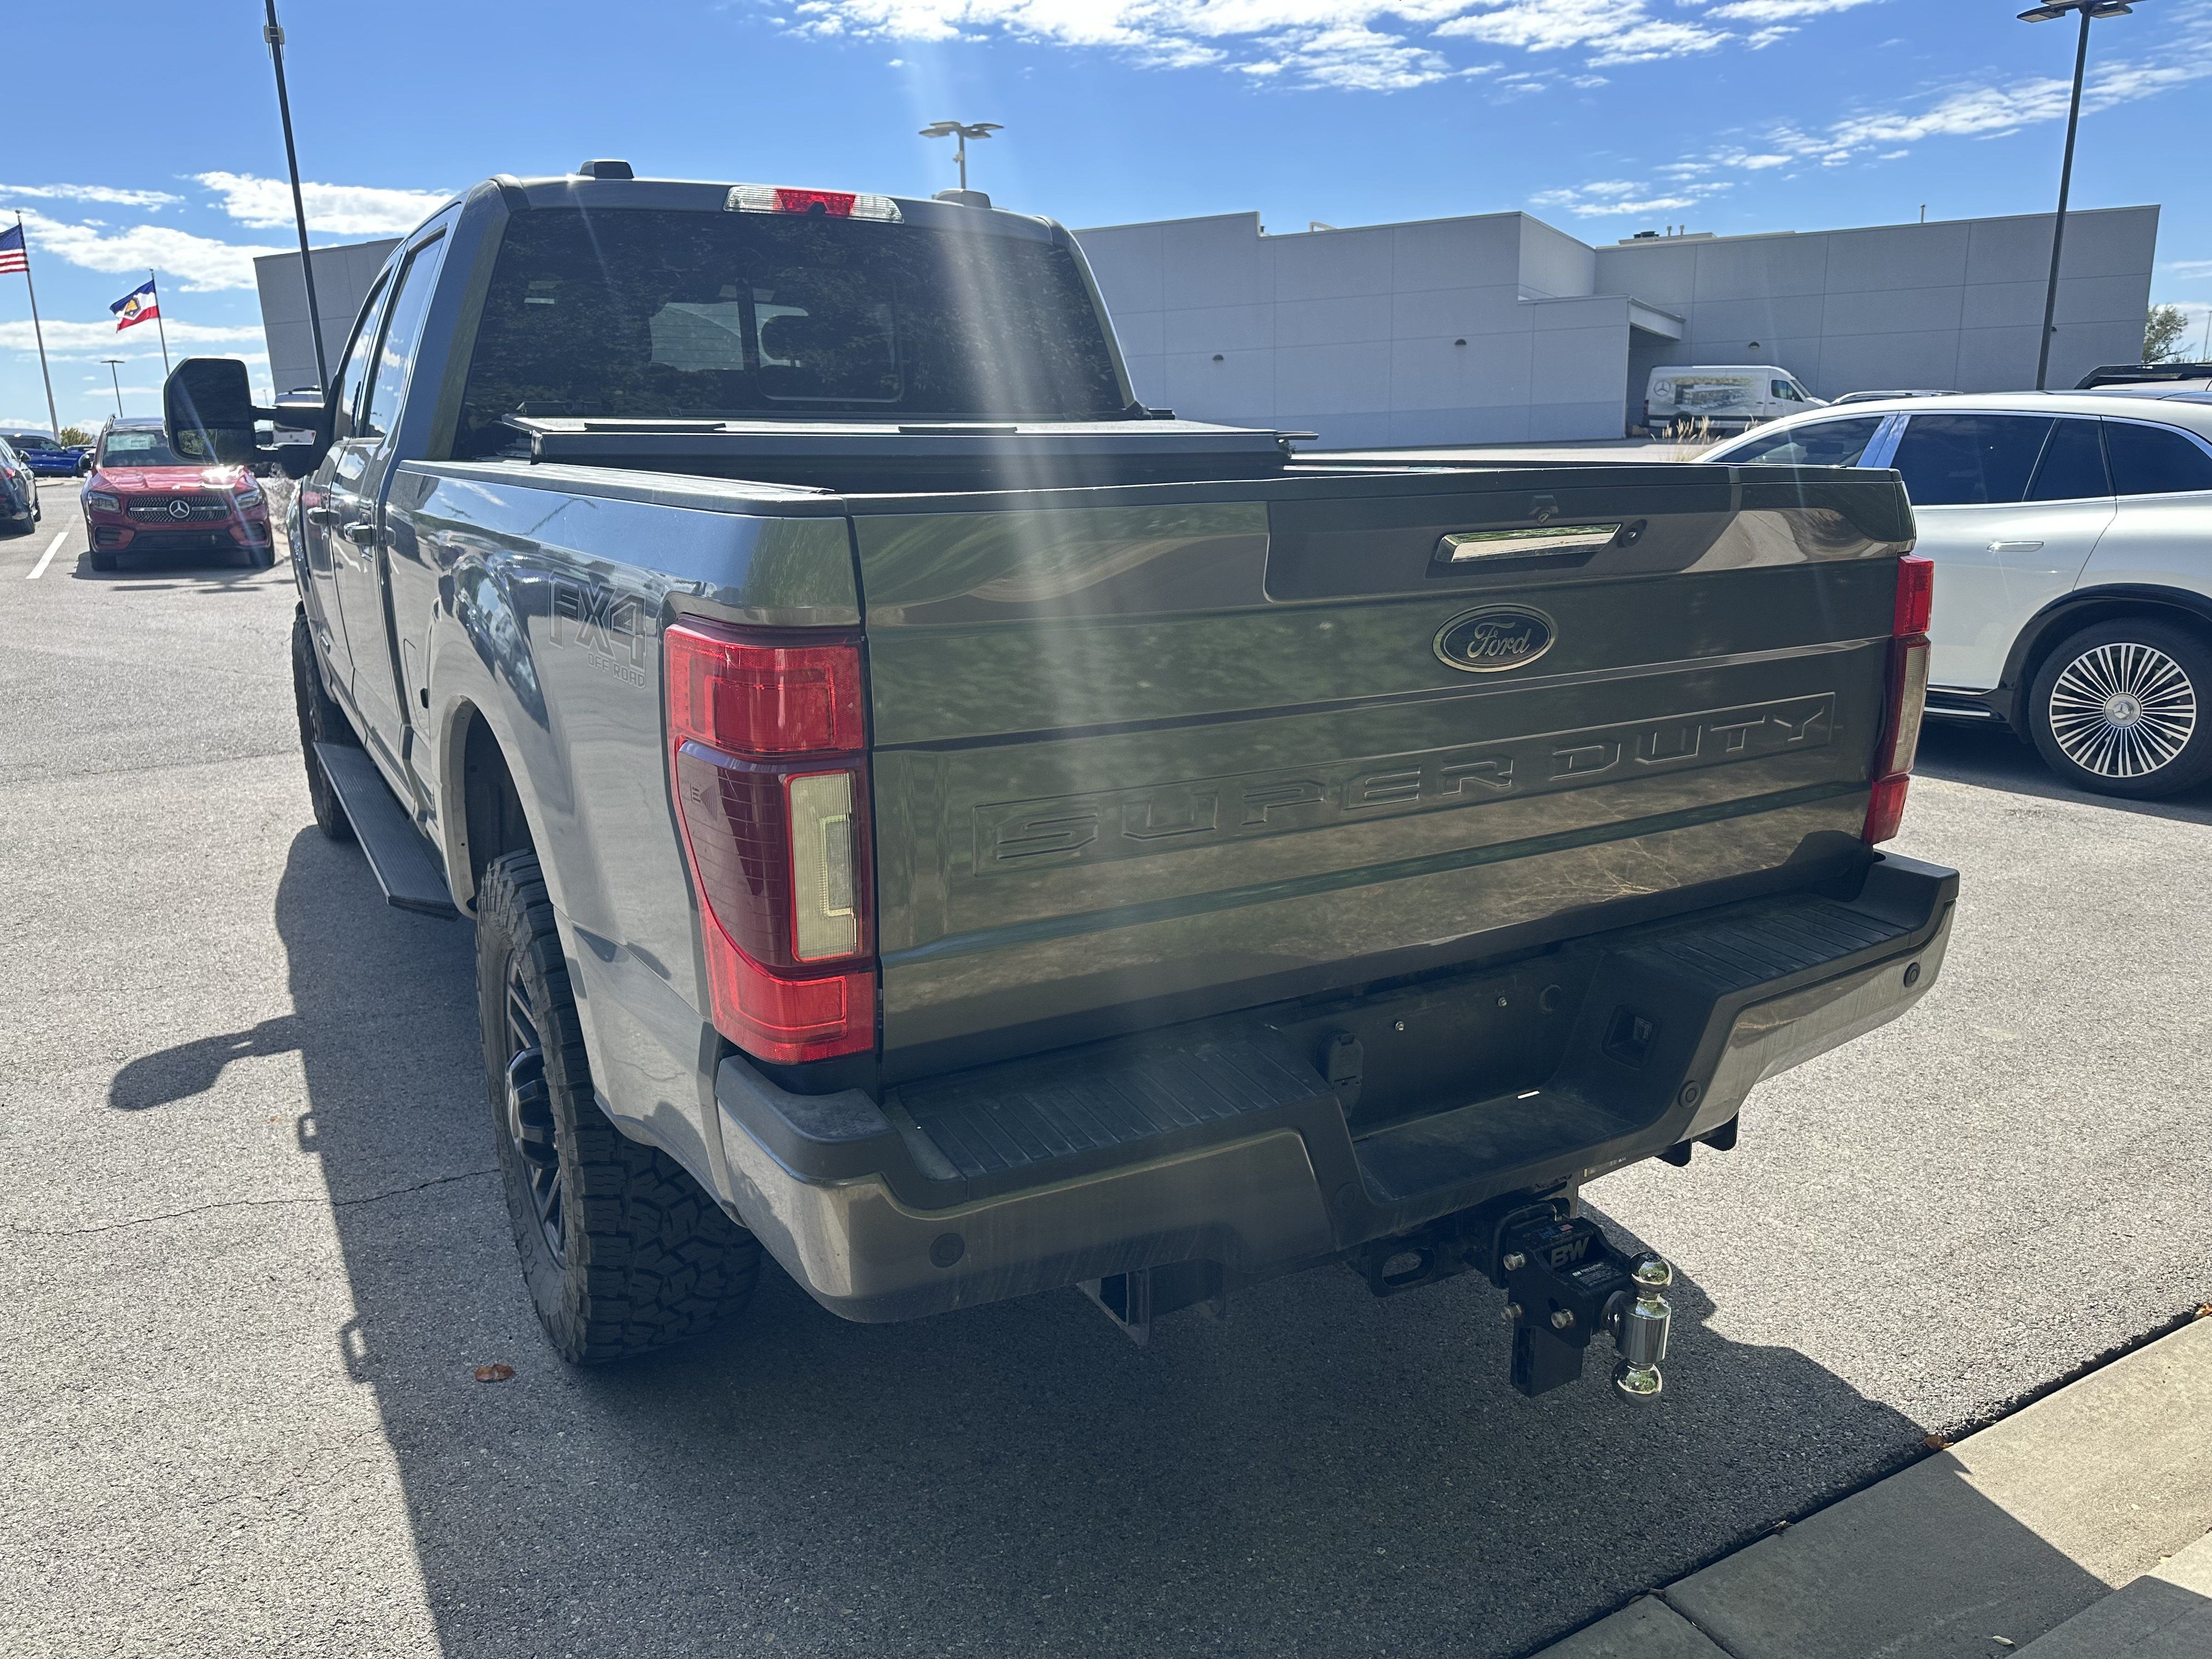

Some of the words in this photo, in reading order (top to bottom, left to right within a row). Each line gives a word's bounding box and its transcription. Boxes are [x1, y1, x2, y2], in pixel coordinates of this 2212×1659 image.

[549, 569, 646, 671] FX4
[1466, 622, 1531, 658] Ford
[588, 651, 609, 672] OFF
[613, 662, 646, 690] ROAD
[996, 756, 1512, 861] SUPER
[1550, 705, 1825, 780] DUTY
